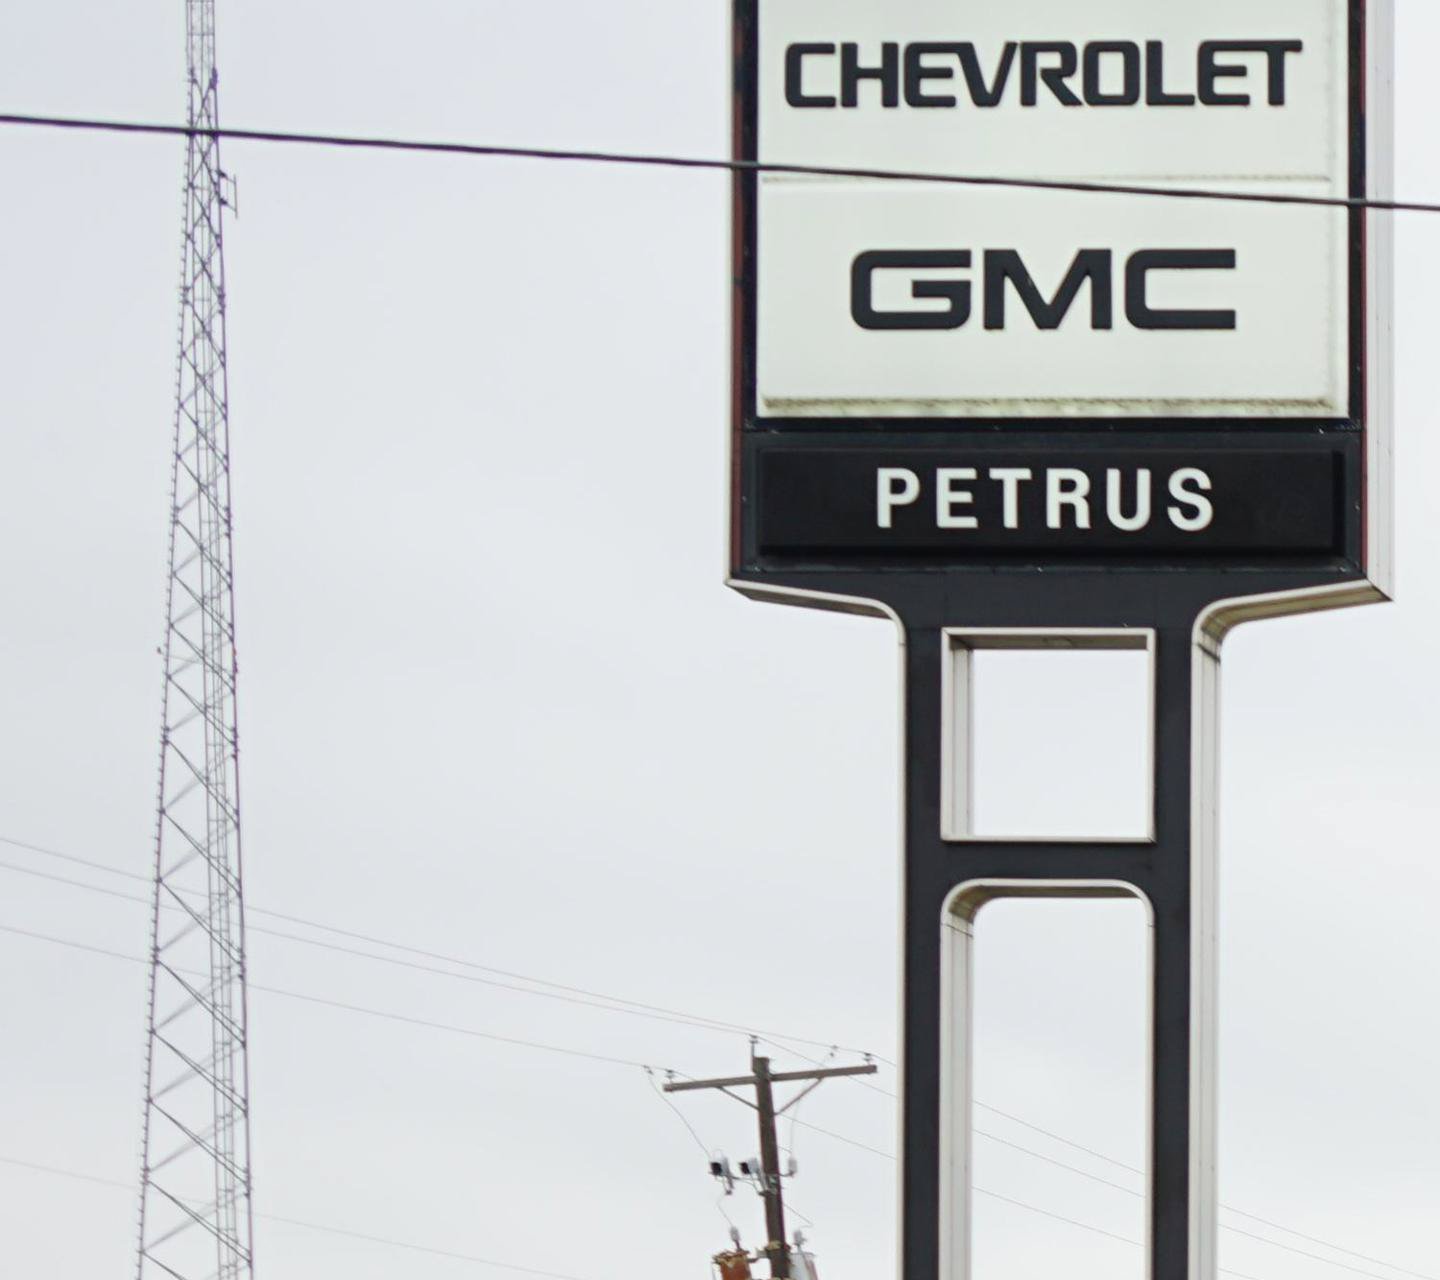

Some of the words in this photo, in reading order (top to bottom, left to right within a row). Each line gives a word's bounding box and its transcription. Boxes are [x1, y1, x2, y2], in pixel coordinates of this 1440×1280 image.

[785, 40, 1303, 108] CHEVROLET
[850, 248, 1236, 330] GMC
[876, 467, 1214, 531] PETRUS
